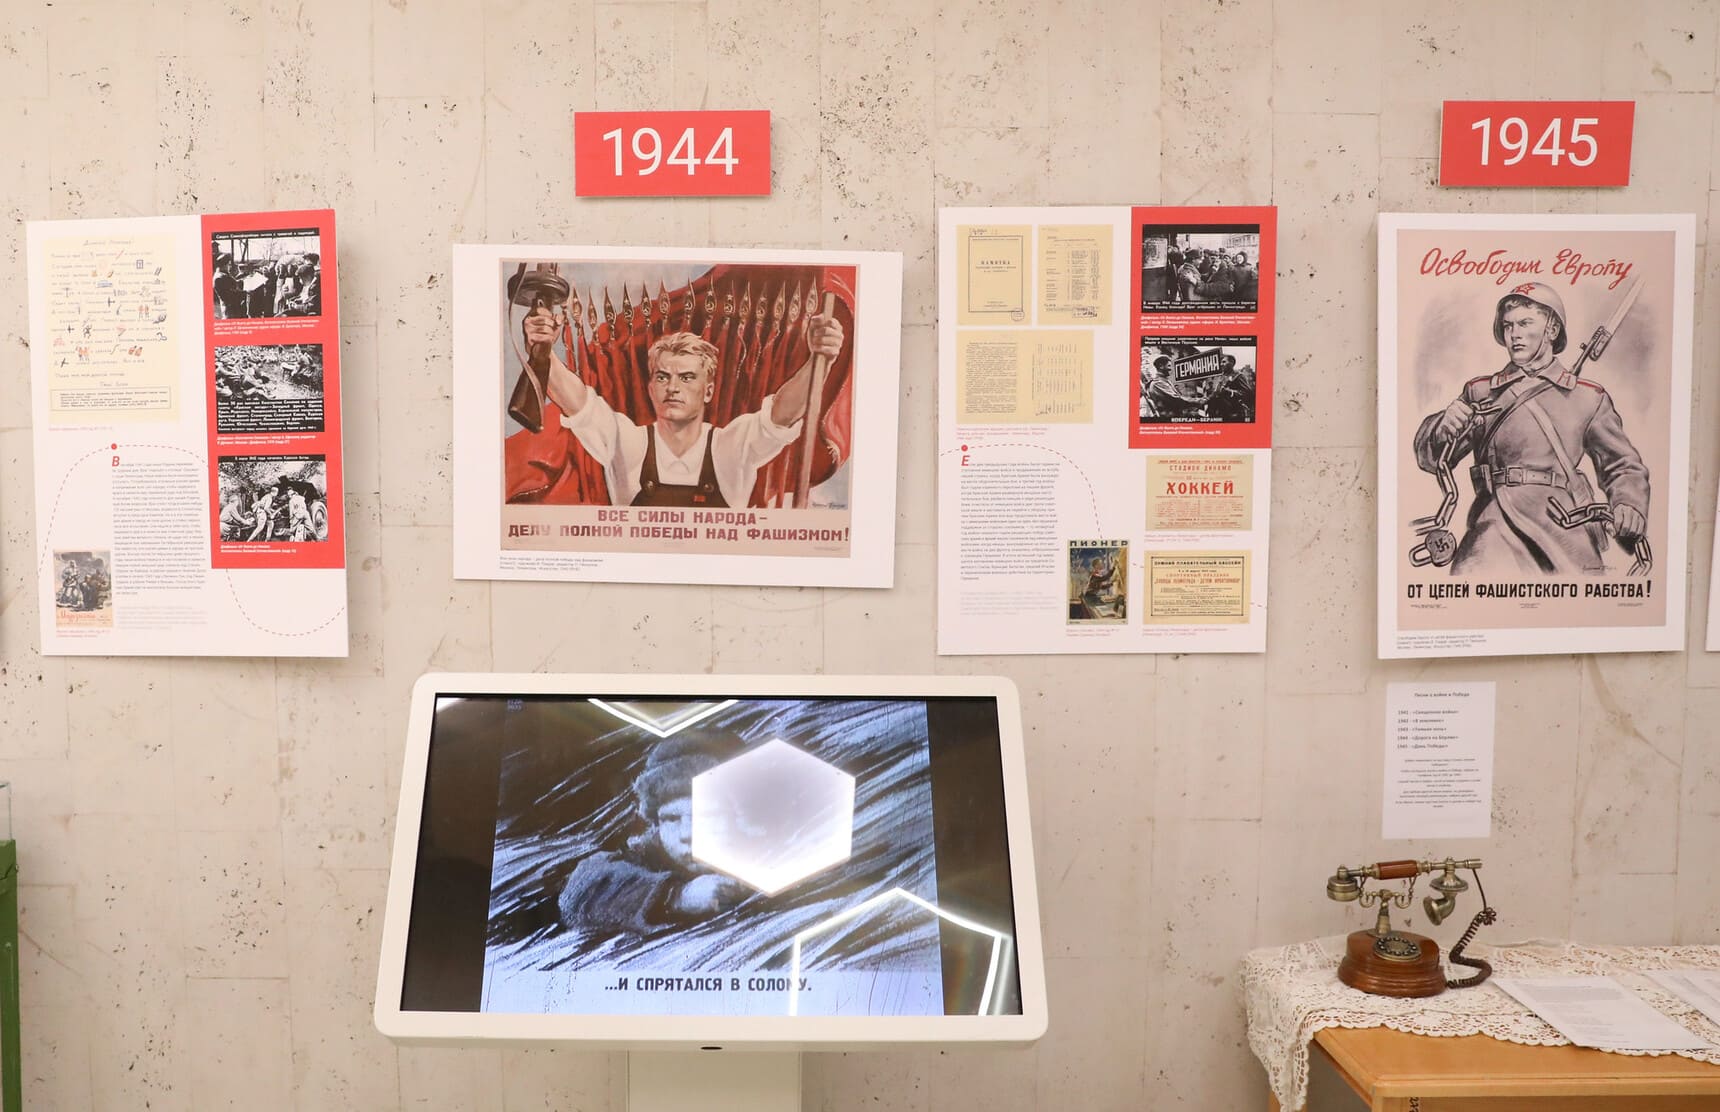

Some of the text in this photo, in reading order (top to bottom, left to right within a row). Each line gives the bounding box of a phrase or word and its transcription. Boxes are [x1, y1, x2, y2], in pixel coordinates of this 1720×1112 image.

[602, 126, 739, 177] 1944
[1471, 116, 1599, 167] 1945
[1420, 247, 1633, 290] Освободим Европу
[1175, 354, 1220, 378] ГЕРМАНИЯ
[1166, 480, 1234, 494] ХОККЕЙ
[598, 510, 629, 522] ВСЕ
[638, 510, 685, 524] СИЛЫ
[508, 523, 850, 542] ДЕЛУ ПОЛНОЙ ПОБЕДЫ НАД ФАШИЗМОМ!
[1407, 580, 1652, 600] ОТ ЦЕПЕЙ ФАШИСТСКОГО РАБСТВА!
[605, 978, 628, 991] ...И
[636, 978, 723, 992] СПРЯТАЛСЯ
[731, 978, 740, 991] В
